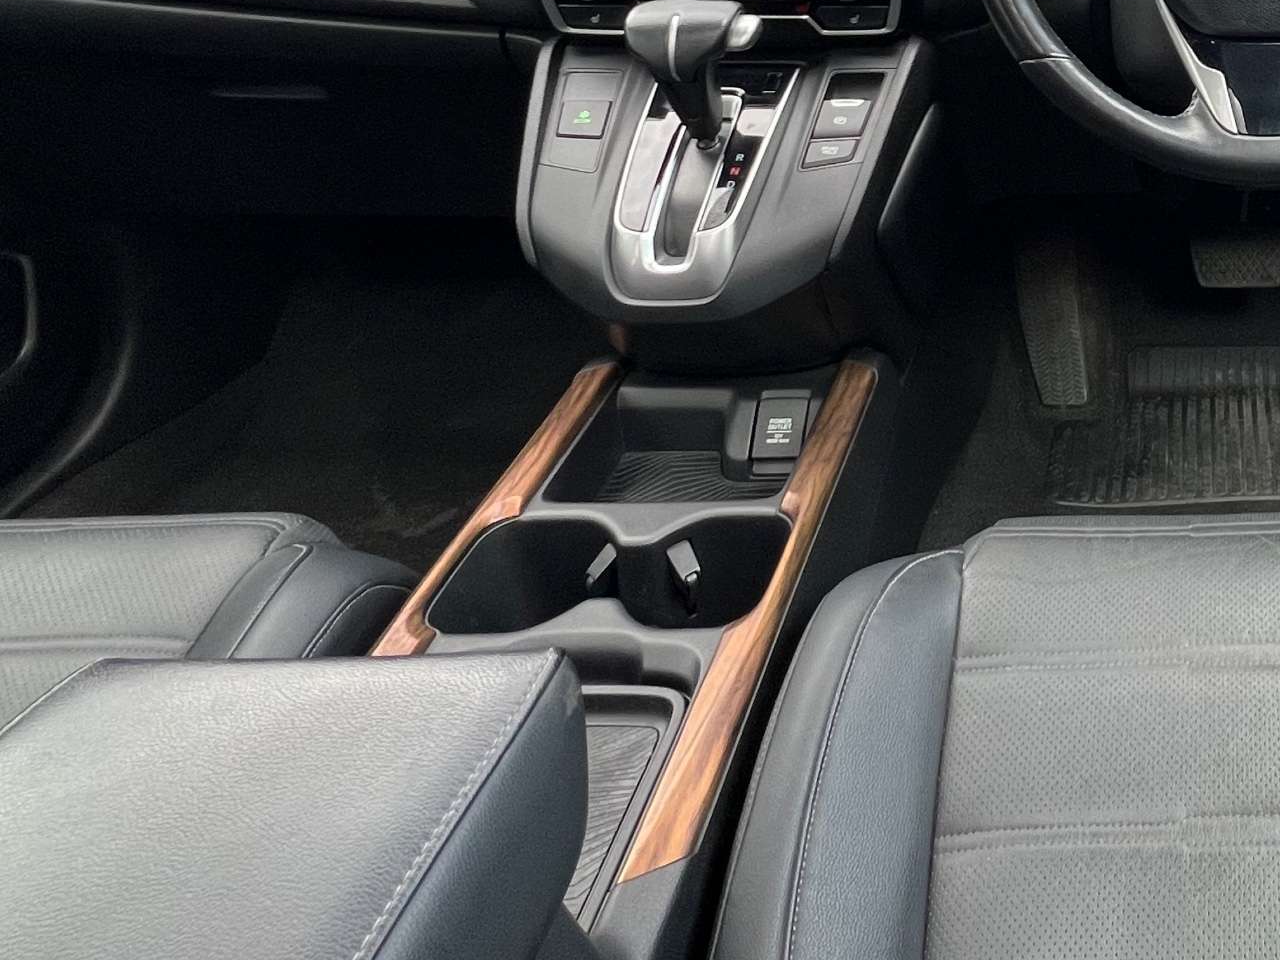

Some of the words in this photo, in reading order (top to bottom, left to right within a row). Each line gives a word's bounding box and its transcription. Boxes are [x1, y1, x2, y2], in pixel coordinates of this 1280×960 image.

[735, 153, 744, 161] R
[730, 166, 741, 175] N
[727, 180, 736, 189] D
